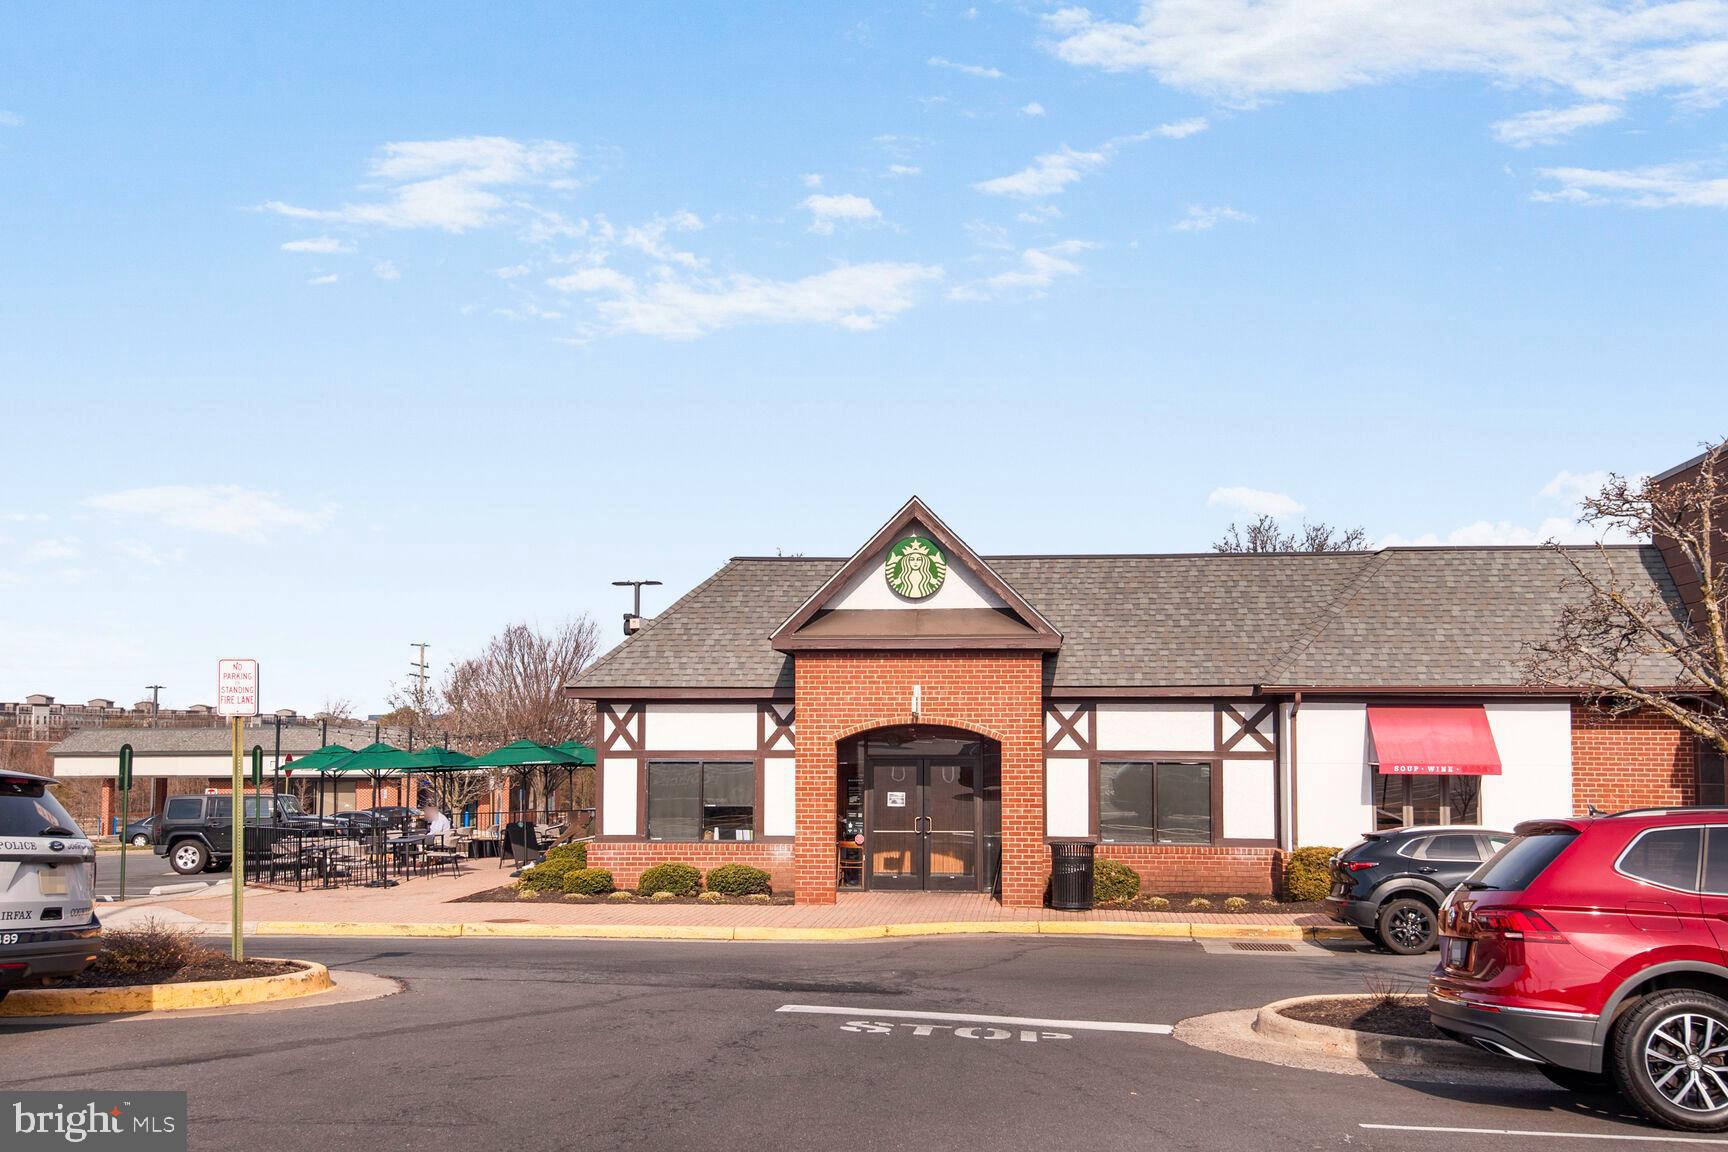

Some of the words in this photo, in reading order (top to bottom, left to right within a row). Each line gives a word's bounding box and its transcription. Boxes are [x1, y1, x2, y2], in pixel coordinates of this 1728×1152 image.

[233, 663, 242, 671] NO
[223, 672, 252, 680] PARKING
[221, 686, 254, 694] STANDING
[220, 695, 235, 704] FIRE
[237, 695, 254, 704] LANE
[1427, 765, 1453, 773] WINE
[0, 910, 33, 920] IRFAX
[839, 1020, 1073, 1043] STOP
